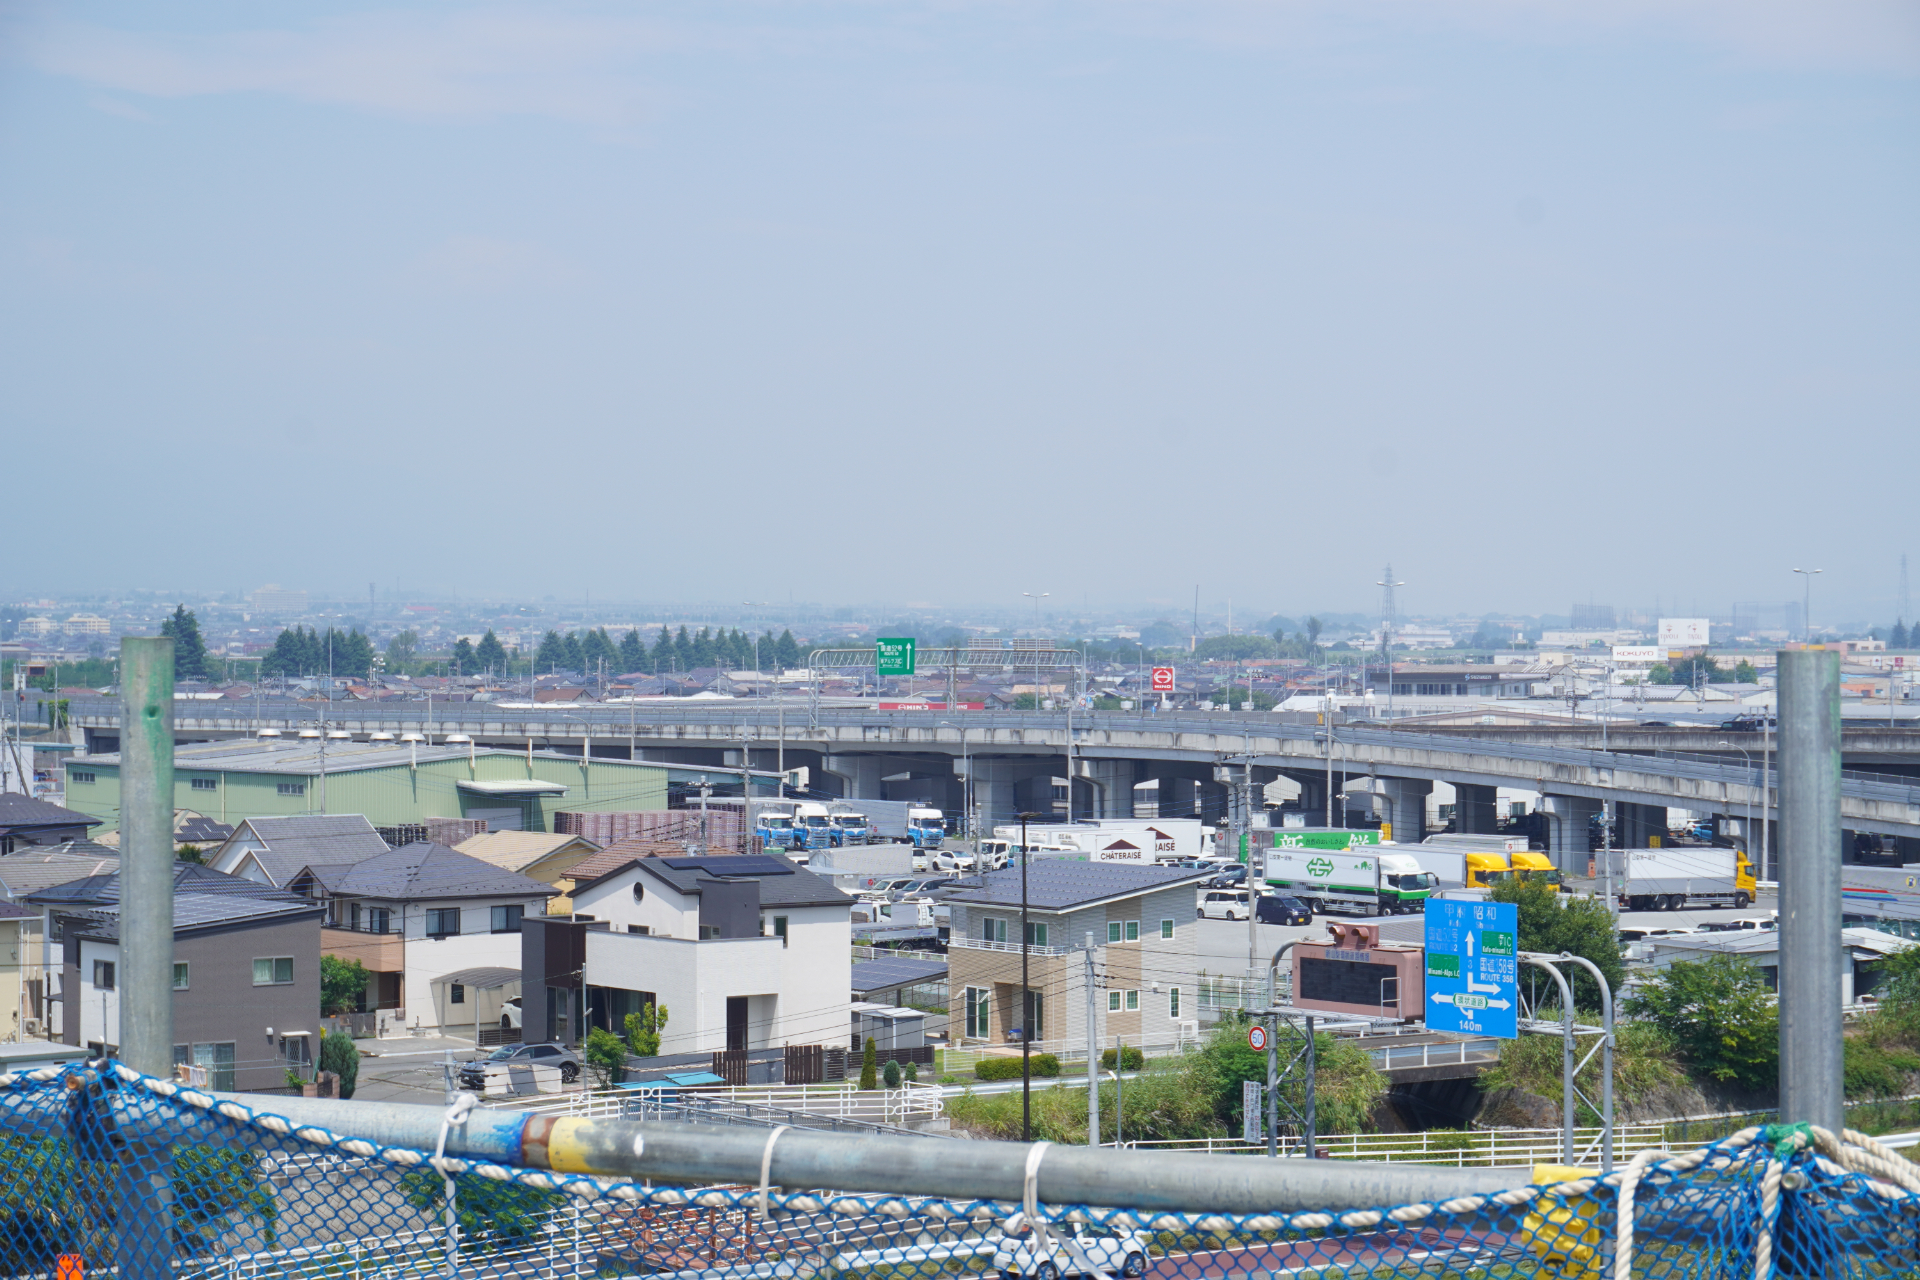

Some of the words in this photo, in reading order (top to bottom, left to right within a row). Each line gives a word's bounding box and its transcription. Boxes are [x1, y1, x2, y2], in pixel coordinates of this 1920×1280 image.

[1100, 848, 1142, 860] CHÂTERAISÉ
[1445, 903, 1466, 918] 甲府
[1474, 905, 1496, 920] 昭和
[1480, 957, 1515, 975] 国道358号
[1480, 972, 1501, 982] ROUTE
[1502, 974, 1514, 983] 358
[1457, 996, 1484, 1007] 環状道路
[1459, 1020, 1482, 1032] 140m
[1252, 1033, 1263, 1045] 50
